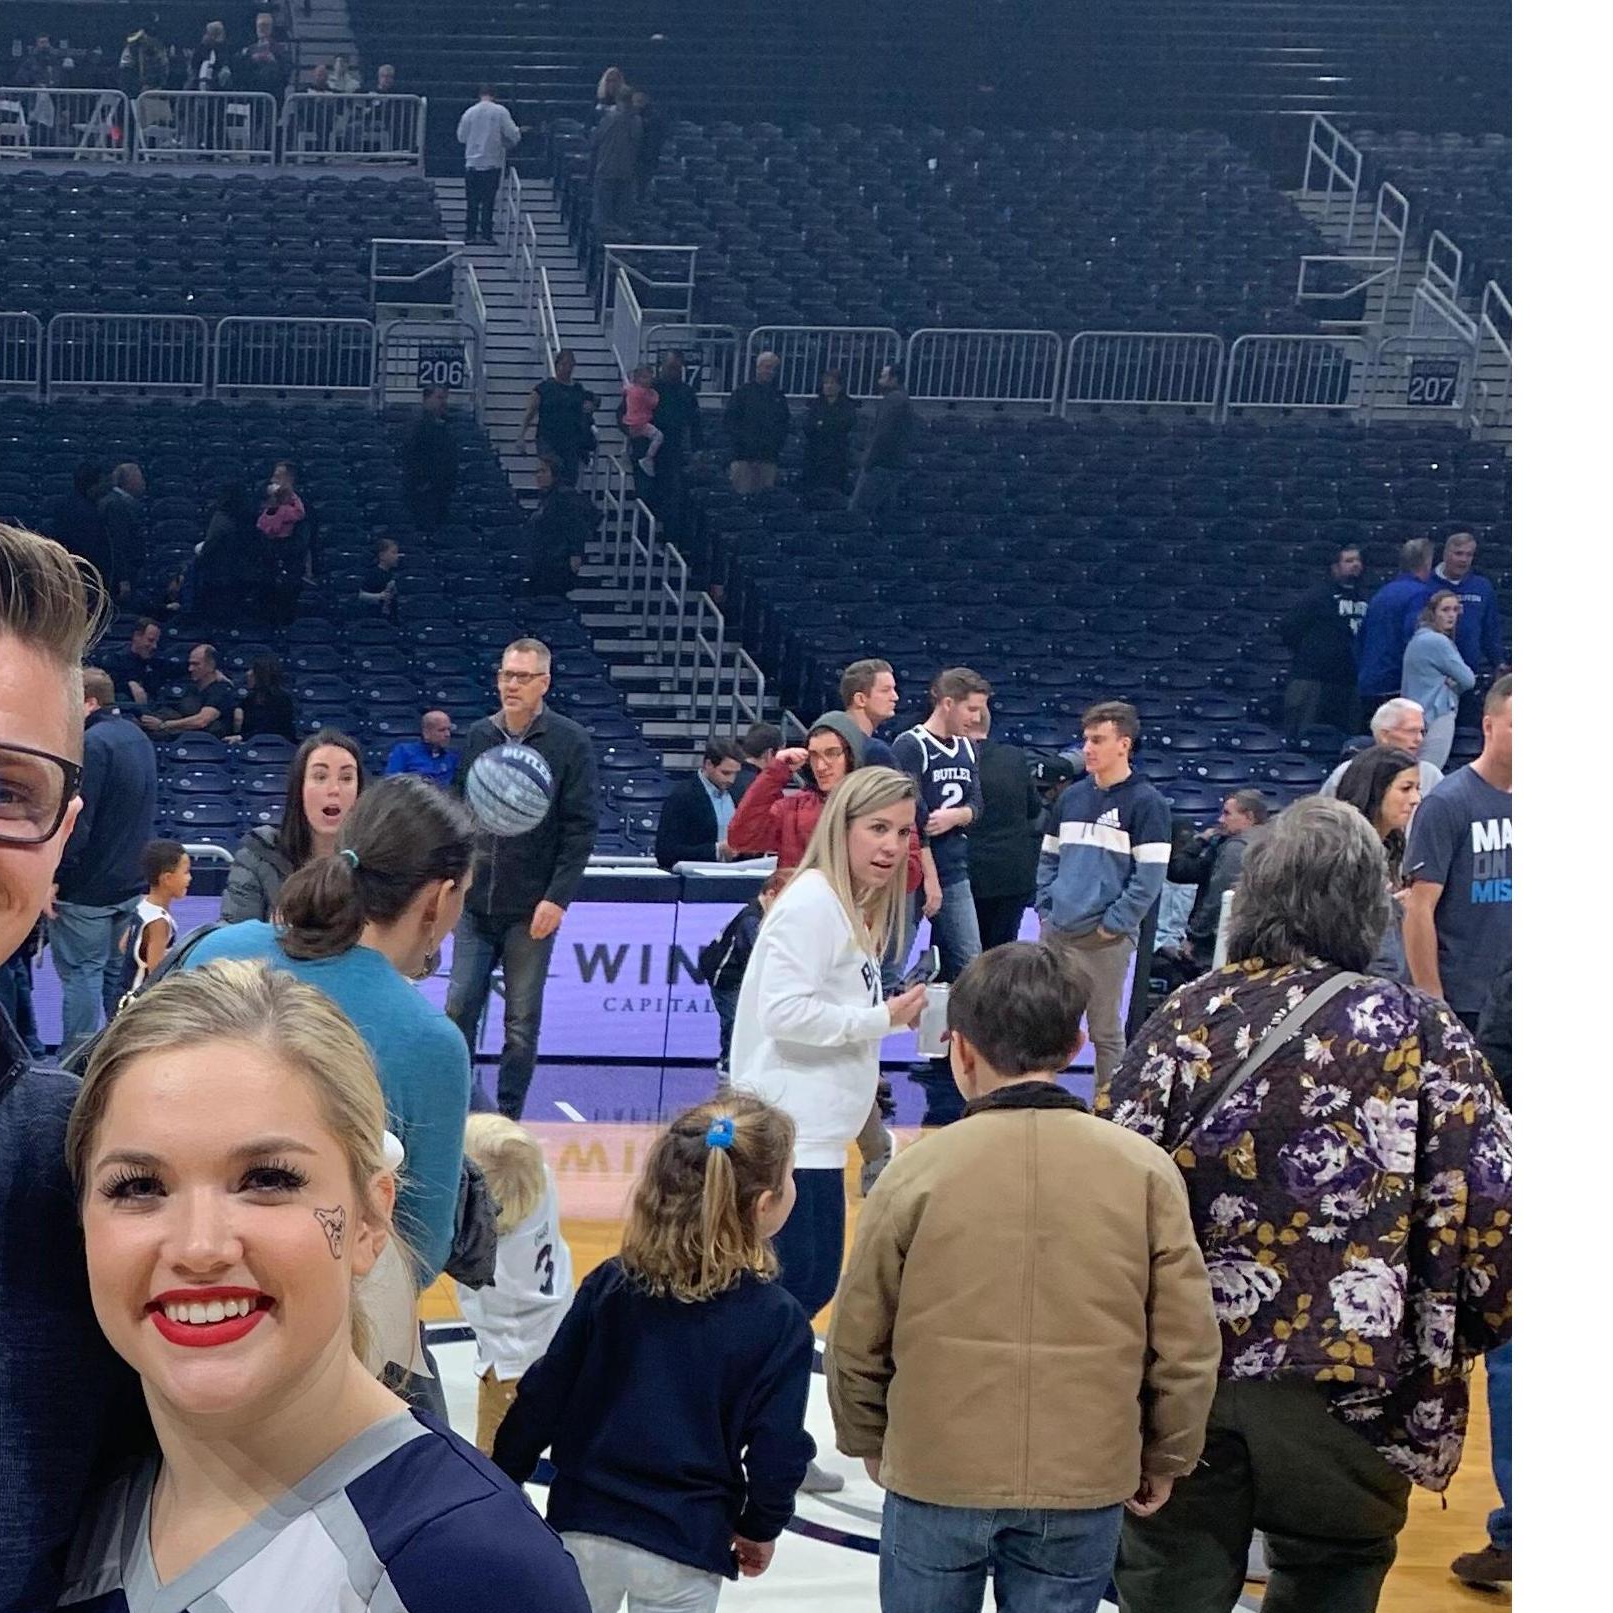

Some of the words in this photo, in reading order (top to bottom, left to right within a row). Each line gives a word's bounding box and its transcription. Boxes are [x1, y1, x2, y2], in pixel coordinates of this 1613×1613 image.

[419, 361, 463, 385] 206
[1410, 377, 1455, 401] 207
[932, 767, 972, 783] BUTLER
[940, 782, 964, 811] 2
[1470, 818, 1512, 853] MA
[1472, 851, 1507, 880] ON
[1470, 879, 1512, 904] MIS
[603, 997, 714, 1013] CAPITAL
[535, 1243, 555, 1296] 3
